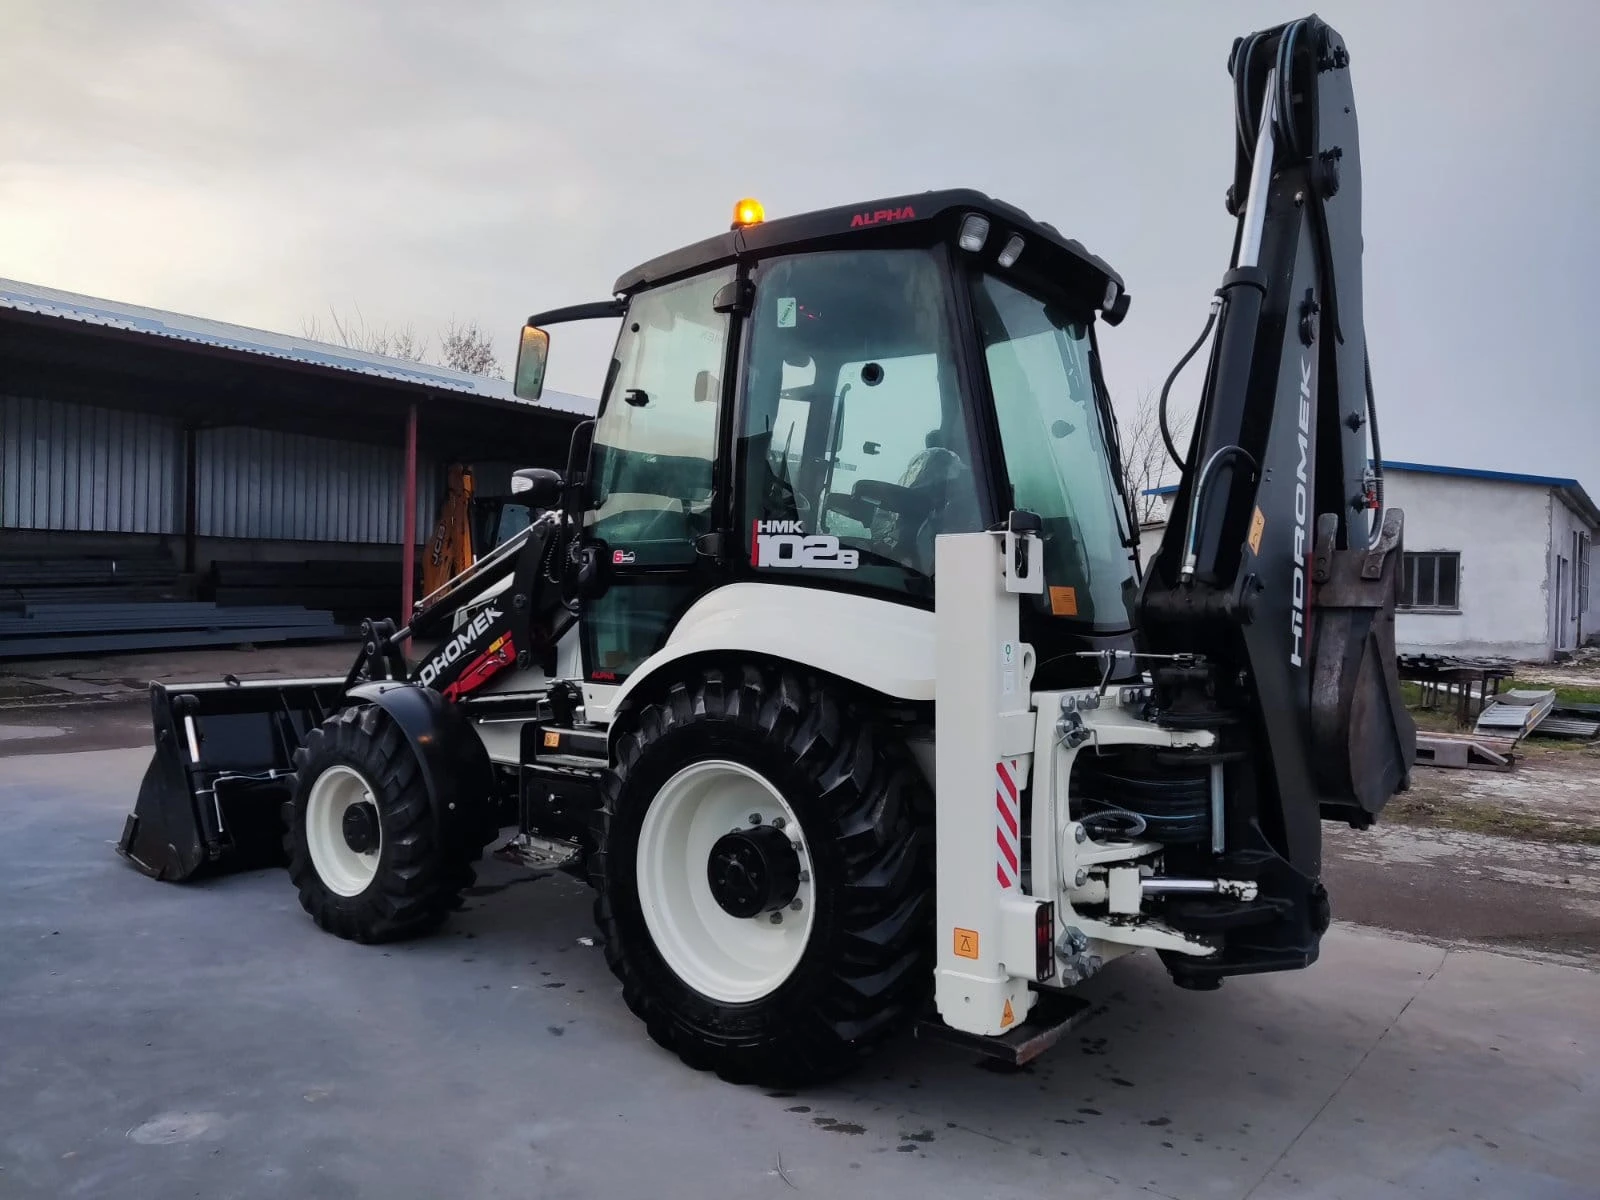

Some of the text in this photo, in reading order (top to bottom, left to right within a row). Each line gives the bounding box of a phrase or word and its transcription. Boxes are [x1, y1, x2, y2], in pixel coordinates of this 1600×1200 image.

[850, 205, 915, 227] ALPHA
[757, 520, 803, 533] HMK
[413, 606, 504, 688] DROMEK
